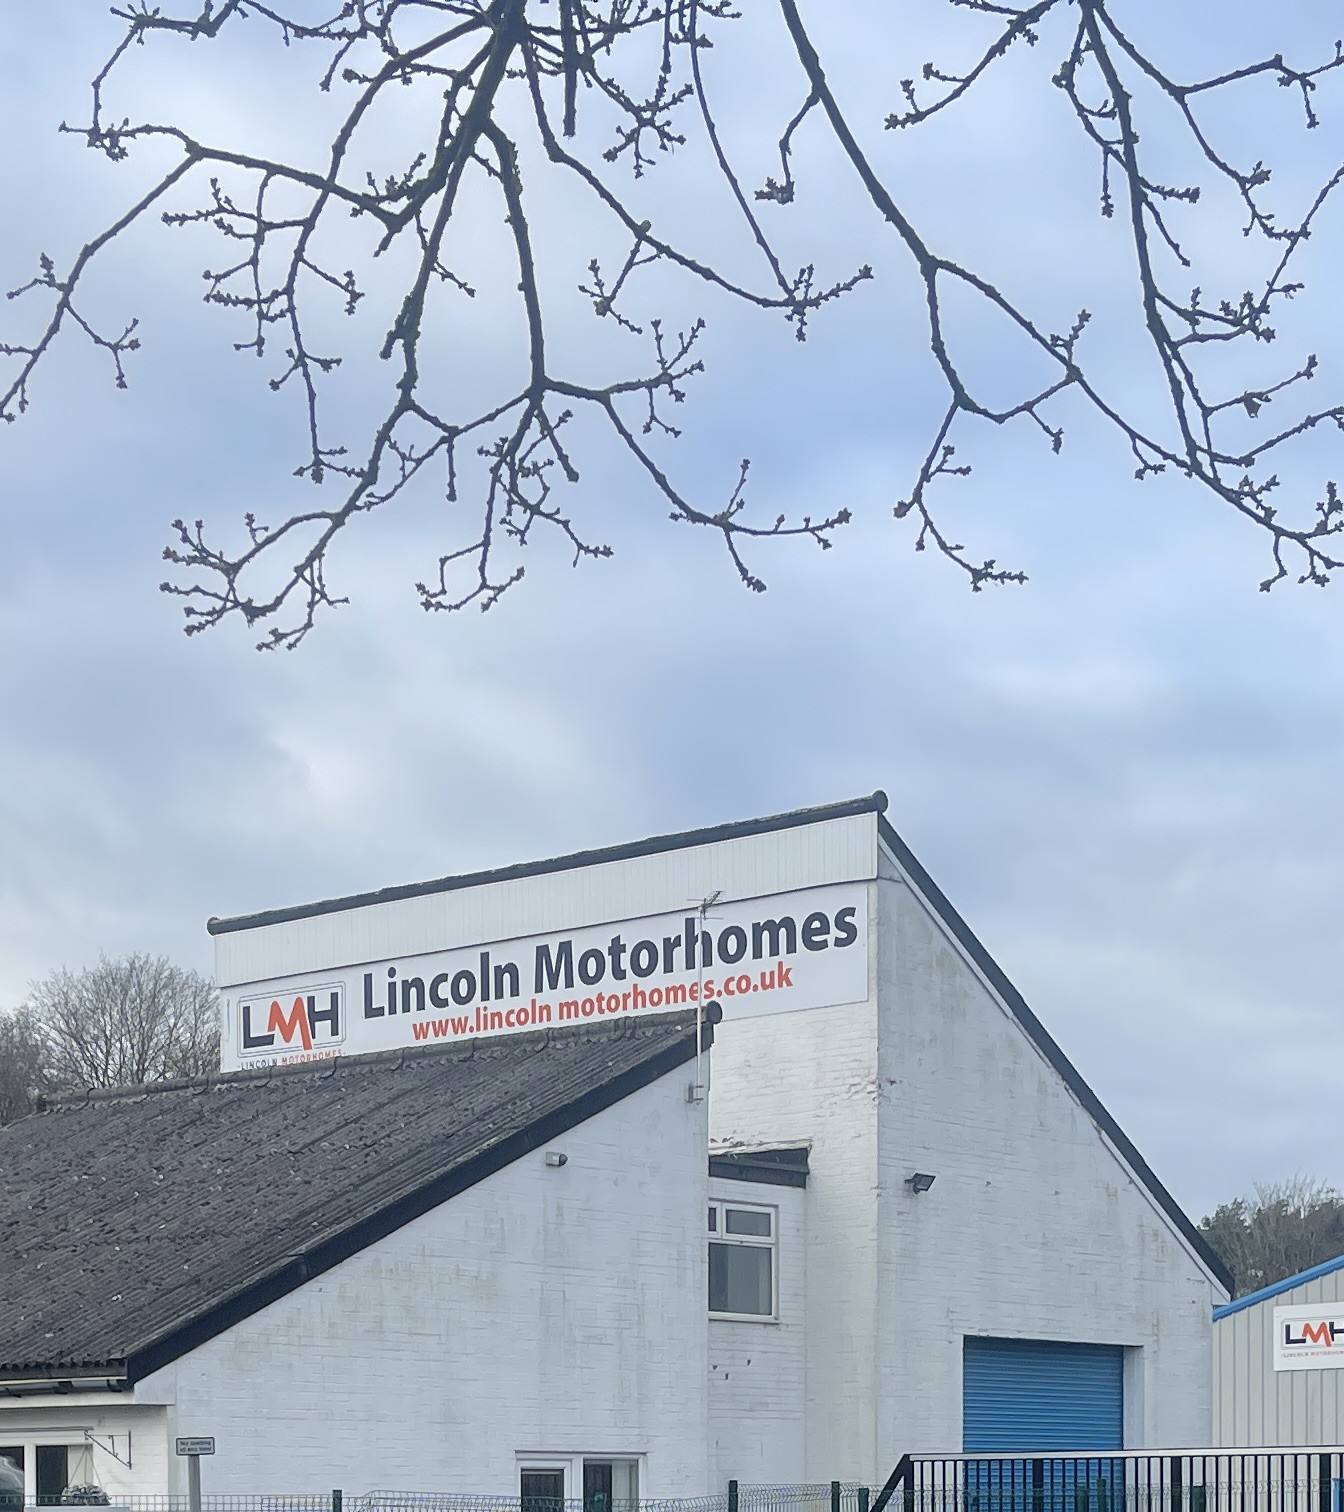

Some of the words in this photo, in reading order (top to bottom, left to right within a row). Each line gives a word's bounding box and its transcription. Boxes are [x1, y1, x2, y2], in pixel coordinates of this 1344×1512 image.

[363, 951, 521, 1020] Lincoln
[535, 906, 858, 994] Motorhomes
[412, 998, 552, 1041] www.lincoln
[558, 961, 794, 1020] motorhomes.co.uk
[242, 992, 339, 1050] LMH
